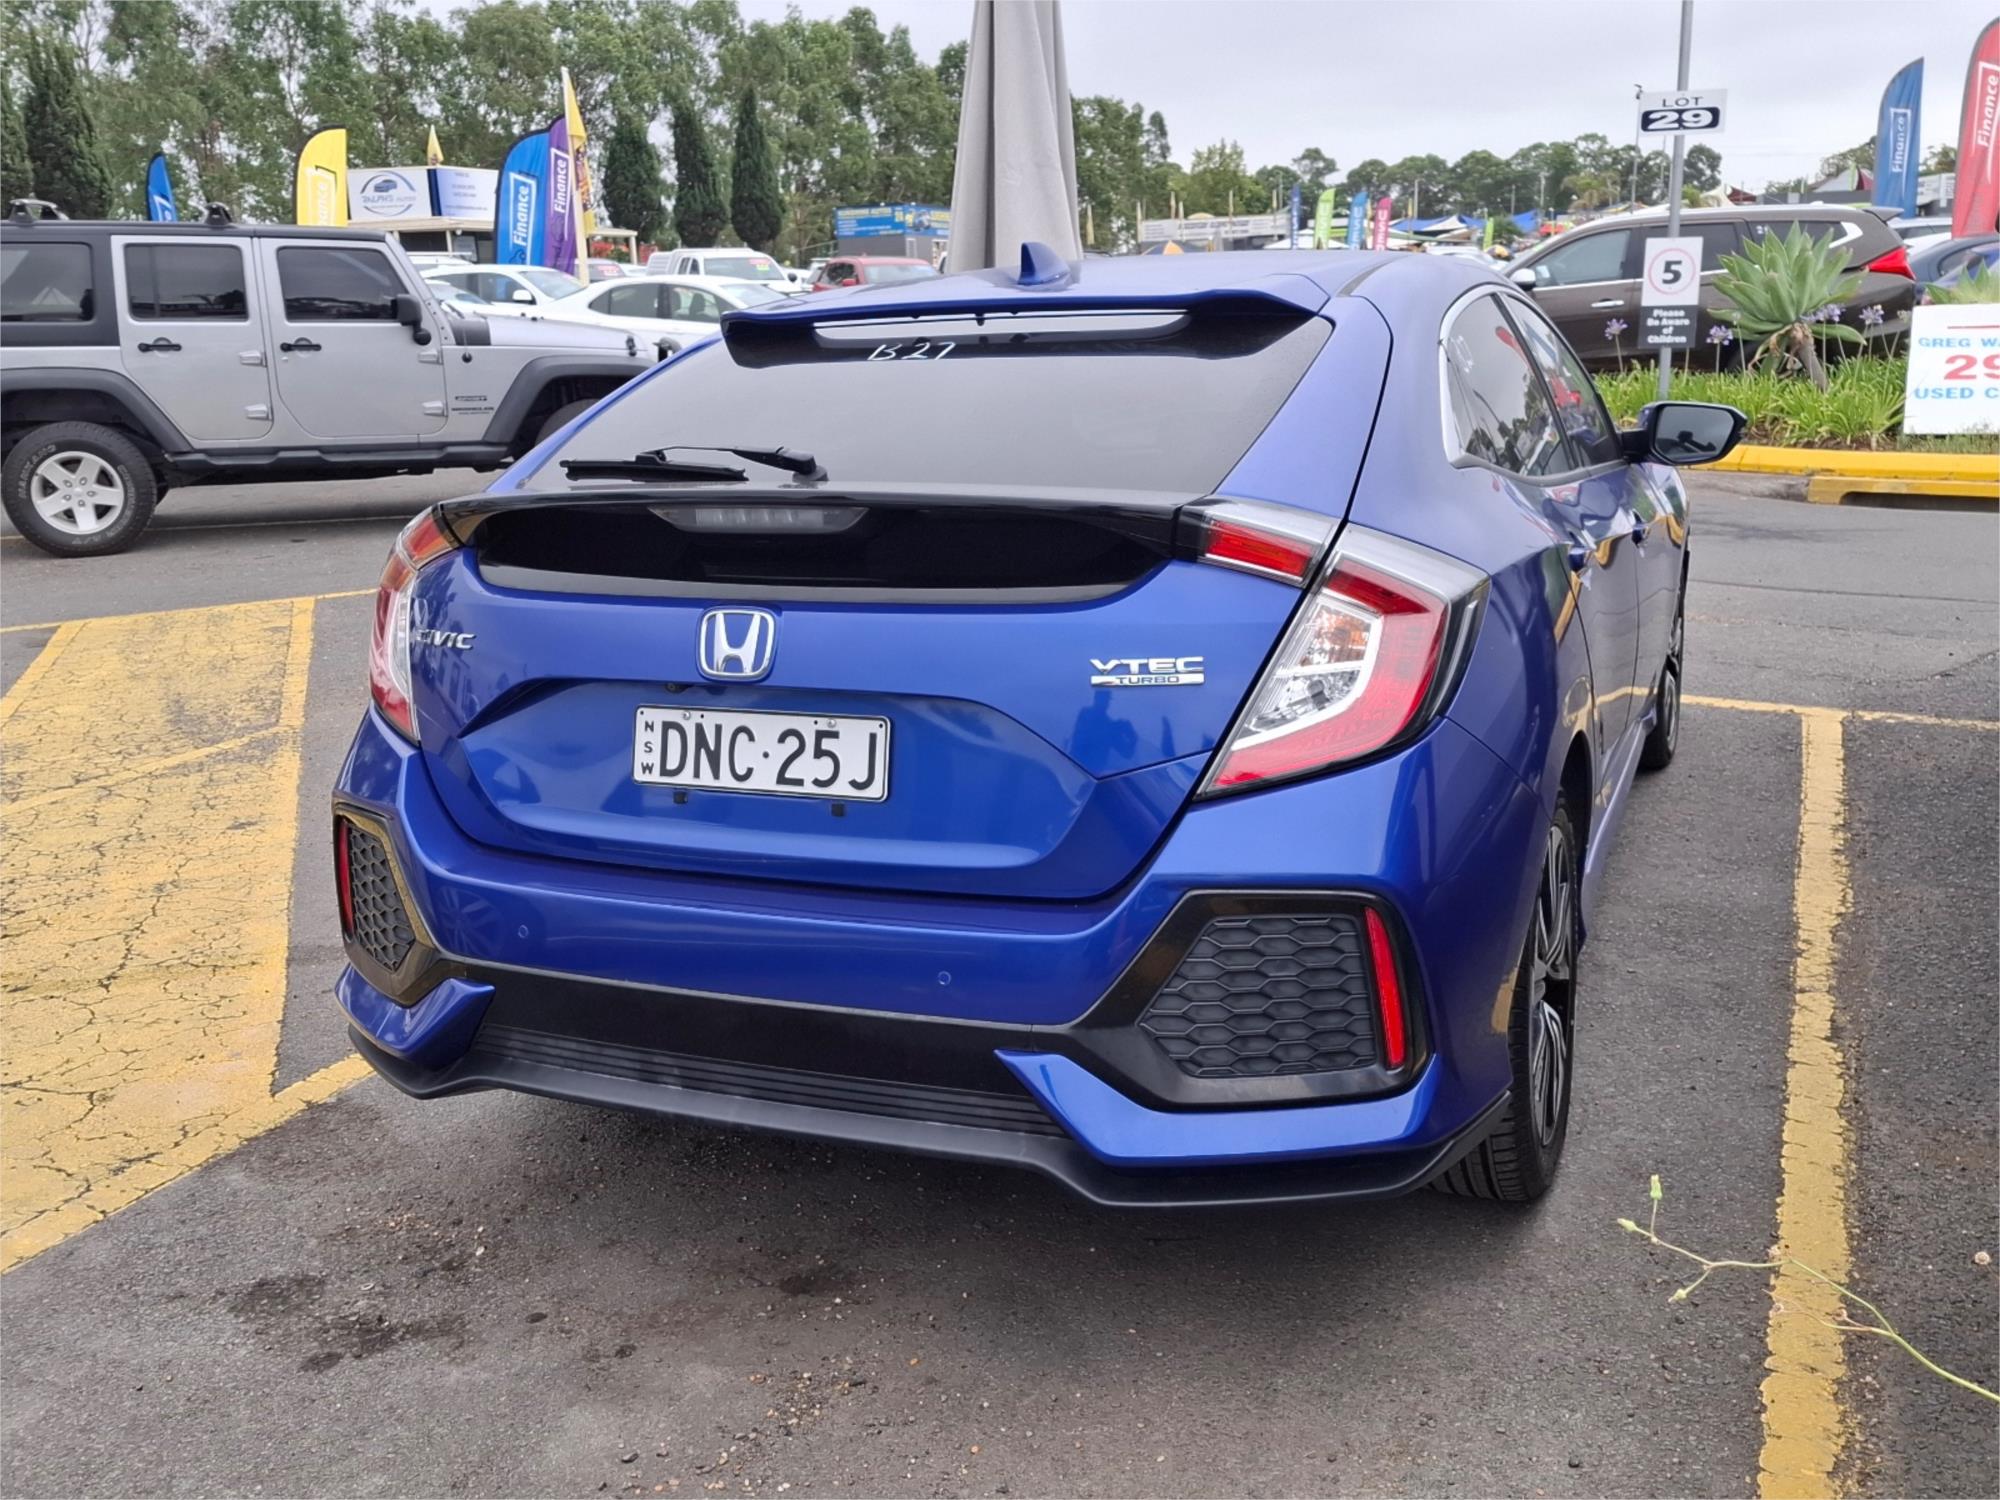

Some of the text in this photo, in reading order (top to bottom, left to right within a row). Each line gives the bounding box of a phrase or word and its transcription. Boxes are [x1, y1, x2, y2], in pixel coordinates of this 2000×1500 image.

[1662, 96, 1704, 108] LOT
[1977, 74, 1999, 149] Finance
[1647, 109, 1713, 130] 29
[1892, 116, 1906, 173] Finance
[553, 158, 568, 214] Finance
[512, 185, 530, 247] Finance
[1661, 260, 1684, 285] 5
[1653, 309, 1685, 317] Please
[1646, 318, 1690, 326] Be Aware
[1662, 326, 1674, 334] of
[1647, 335, 1687, 343] Children
[1918, 337, 1971, 347] GREG
[1914, 387, 1975, 399] USED
[1089, 656, 1204, 675] VTEC
[1115, 676, 1180, 685] TURBO
